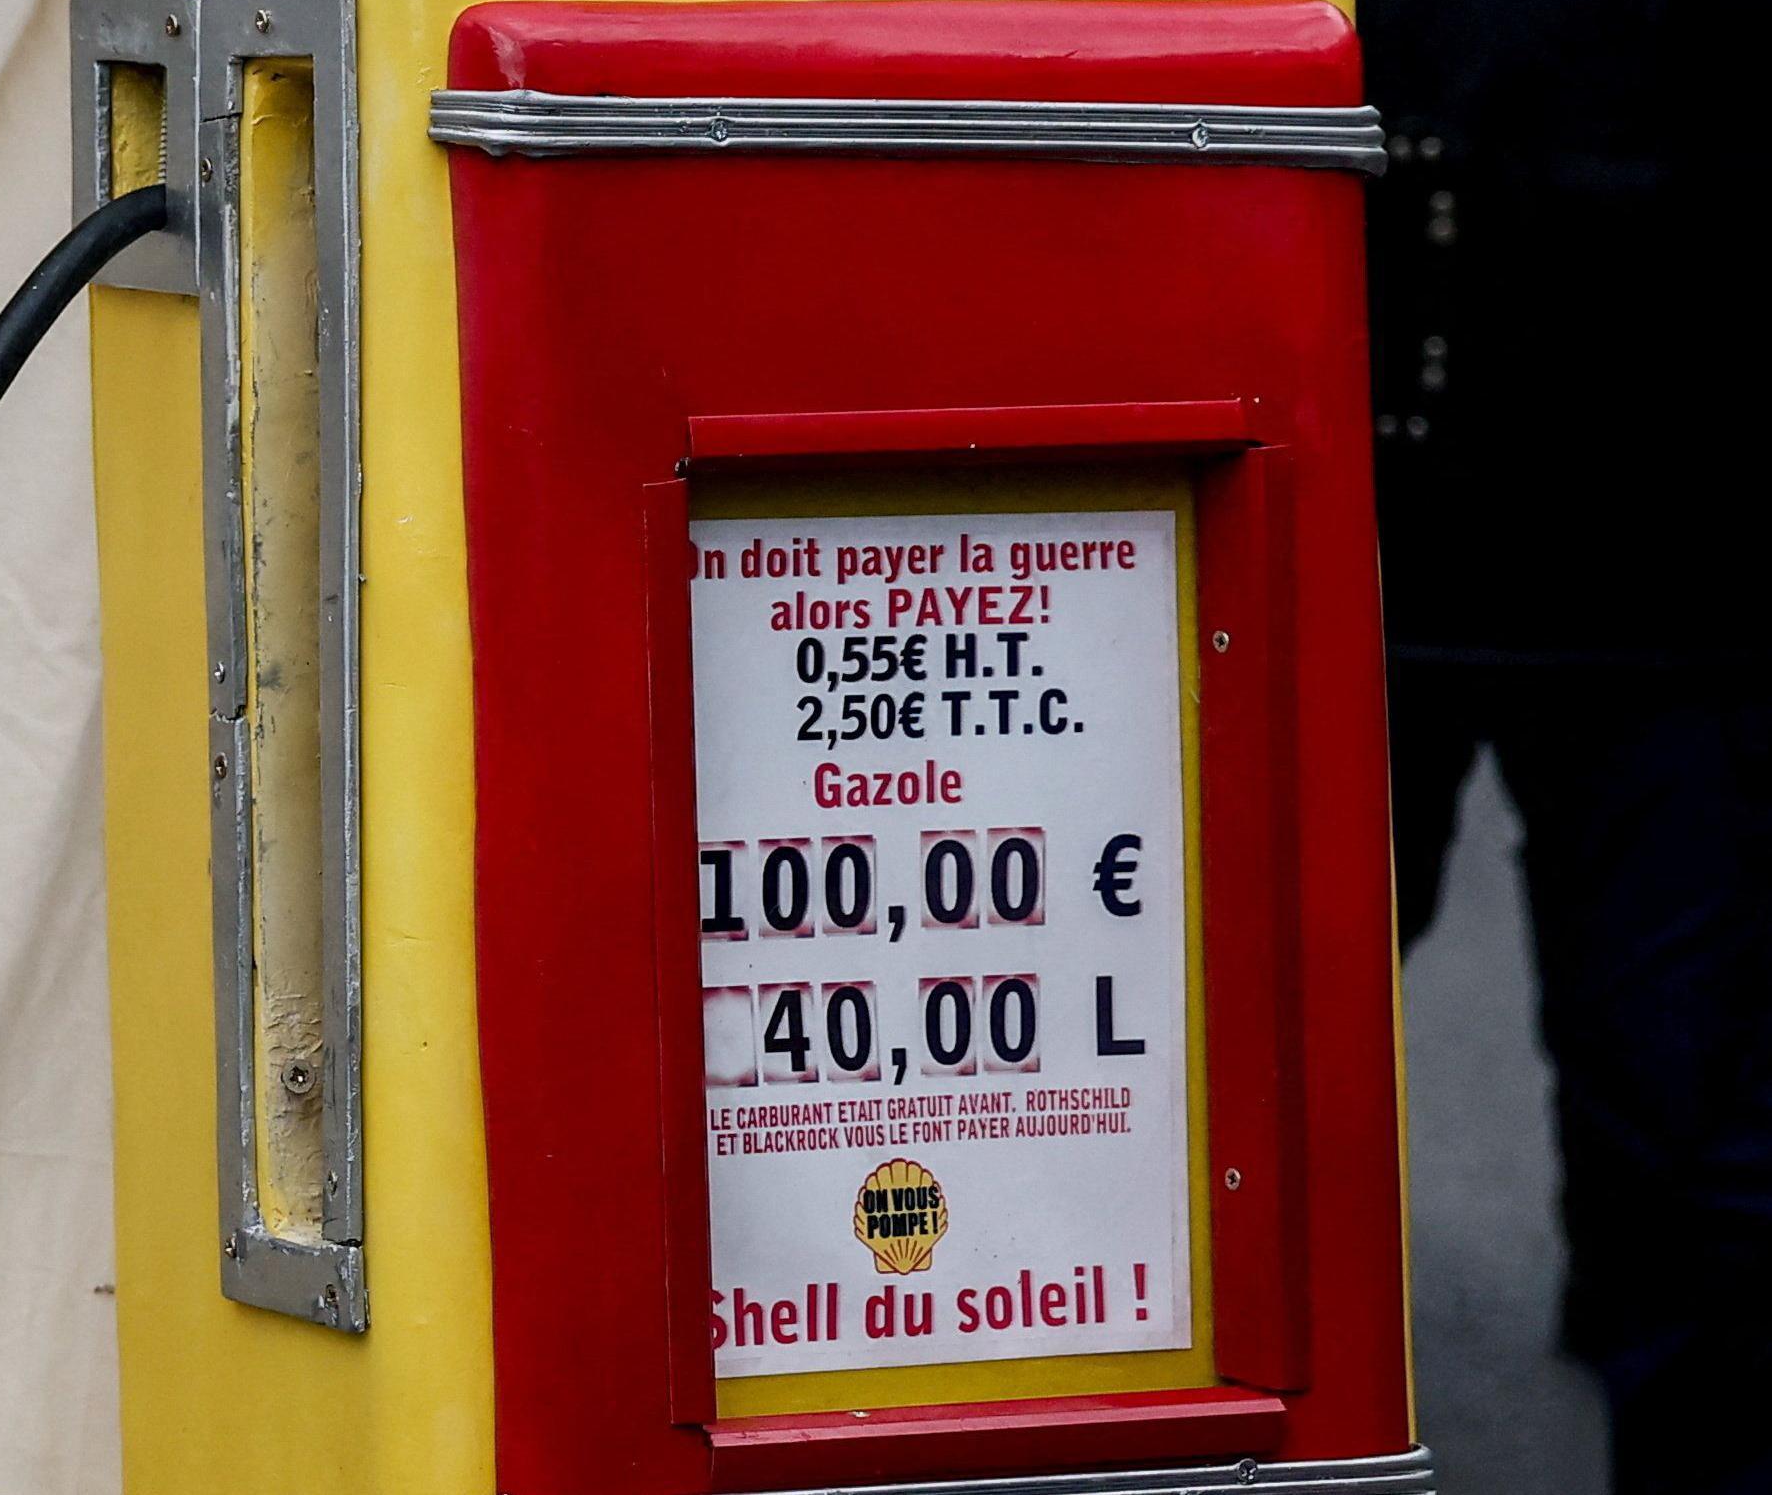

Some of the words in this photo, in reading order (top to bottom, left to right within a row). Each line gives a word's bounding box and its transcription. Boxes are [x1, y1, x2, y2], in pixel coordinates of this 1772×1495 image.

[740, 537, 821, 579] doit
[836, 542, 944, 585] payer
[960, 533, 994, 573] la
[1010, 538, 1136, 581] guerre
[770, 591, 871, 631] alors
[888, 584, 1049, 628] PAYEZ!
[796, 633, 927, 693] 0,55€
[945, 631, 1044, 679] H.T.
[796, 690, 925, 751] 2,50€
[941, 688, 1084, 736] T.T.C.
[814, 759, 962, 809] Gazole
[700, 836, 1039, 943] 100,00
[1092, 833, 1144, 917] €
[763, 978, 1036, 1086] 40,00
[1095, 975, 1146, 1057] L
[710, 1108, 732, 1131] LE
[736, 1102, 833, 1130] CARBURANT
[838, 1099, 883, 1124] ETAIT
[887, 1095, 954, 1120] GRATUIT
[958, 1092, 1016, 1116] AVANT.
[1026, 1087, 1131, 1112] ROTHSCHILD
[716, 1133, 737, 1156] ET
[743, 1128, 839, 1155] BLACKROCK
[844, 1124, 885, 1148] VOUS
[889, 1123, 909, 1145] LE
[913, 1120, 953, 1144] FONT
[957, 1116, 1010, 1141] PAYER
[1015, 1112, 1132, 1138] AUJOURD'HUI.
[863, 1189, 888, 1214] ON
[891, 1186, 940, 1211] VOUS
[867, 1212, 928, 1239] POMPE
[931, 1211, 938, 1235] !
[864, 1285, 933, 1339] du
[957, 1264, 1106, 1333] soleil
[1133, 1262, 1148, 1321] !
